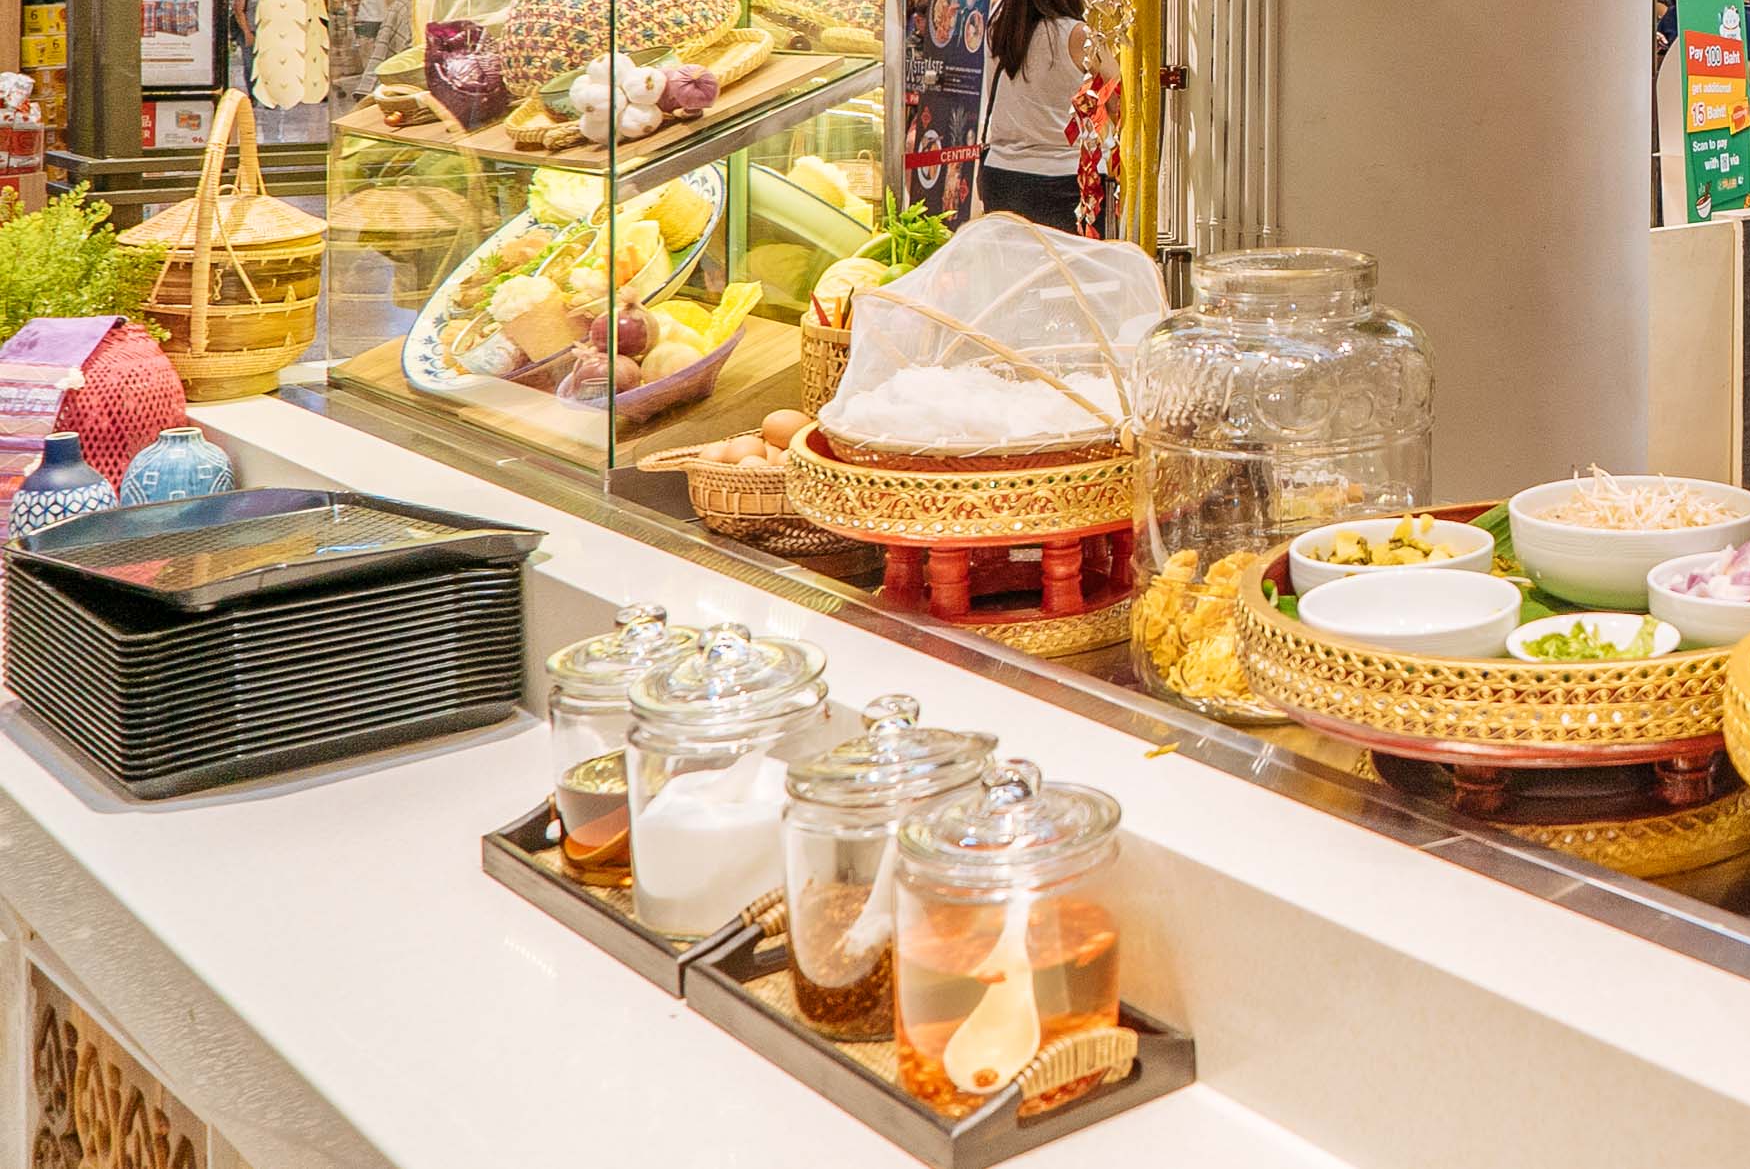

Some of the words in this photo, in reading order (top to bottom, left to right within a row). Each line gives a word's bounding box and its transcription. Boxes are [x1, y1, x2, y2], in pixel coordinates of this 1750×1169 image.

[1689, 45, 1704, 62] Pay
[1705, 45, 1722, 67] 100
[1724, 51, 1741, 65] Baht
[1692, 140, 1708, 152] Scan
